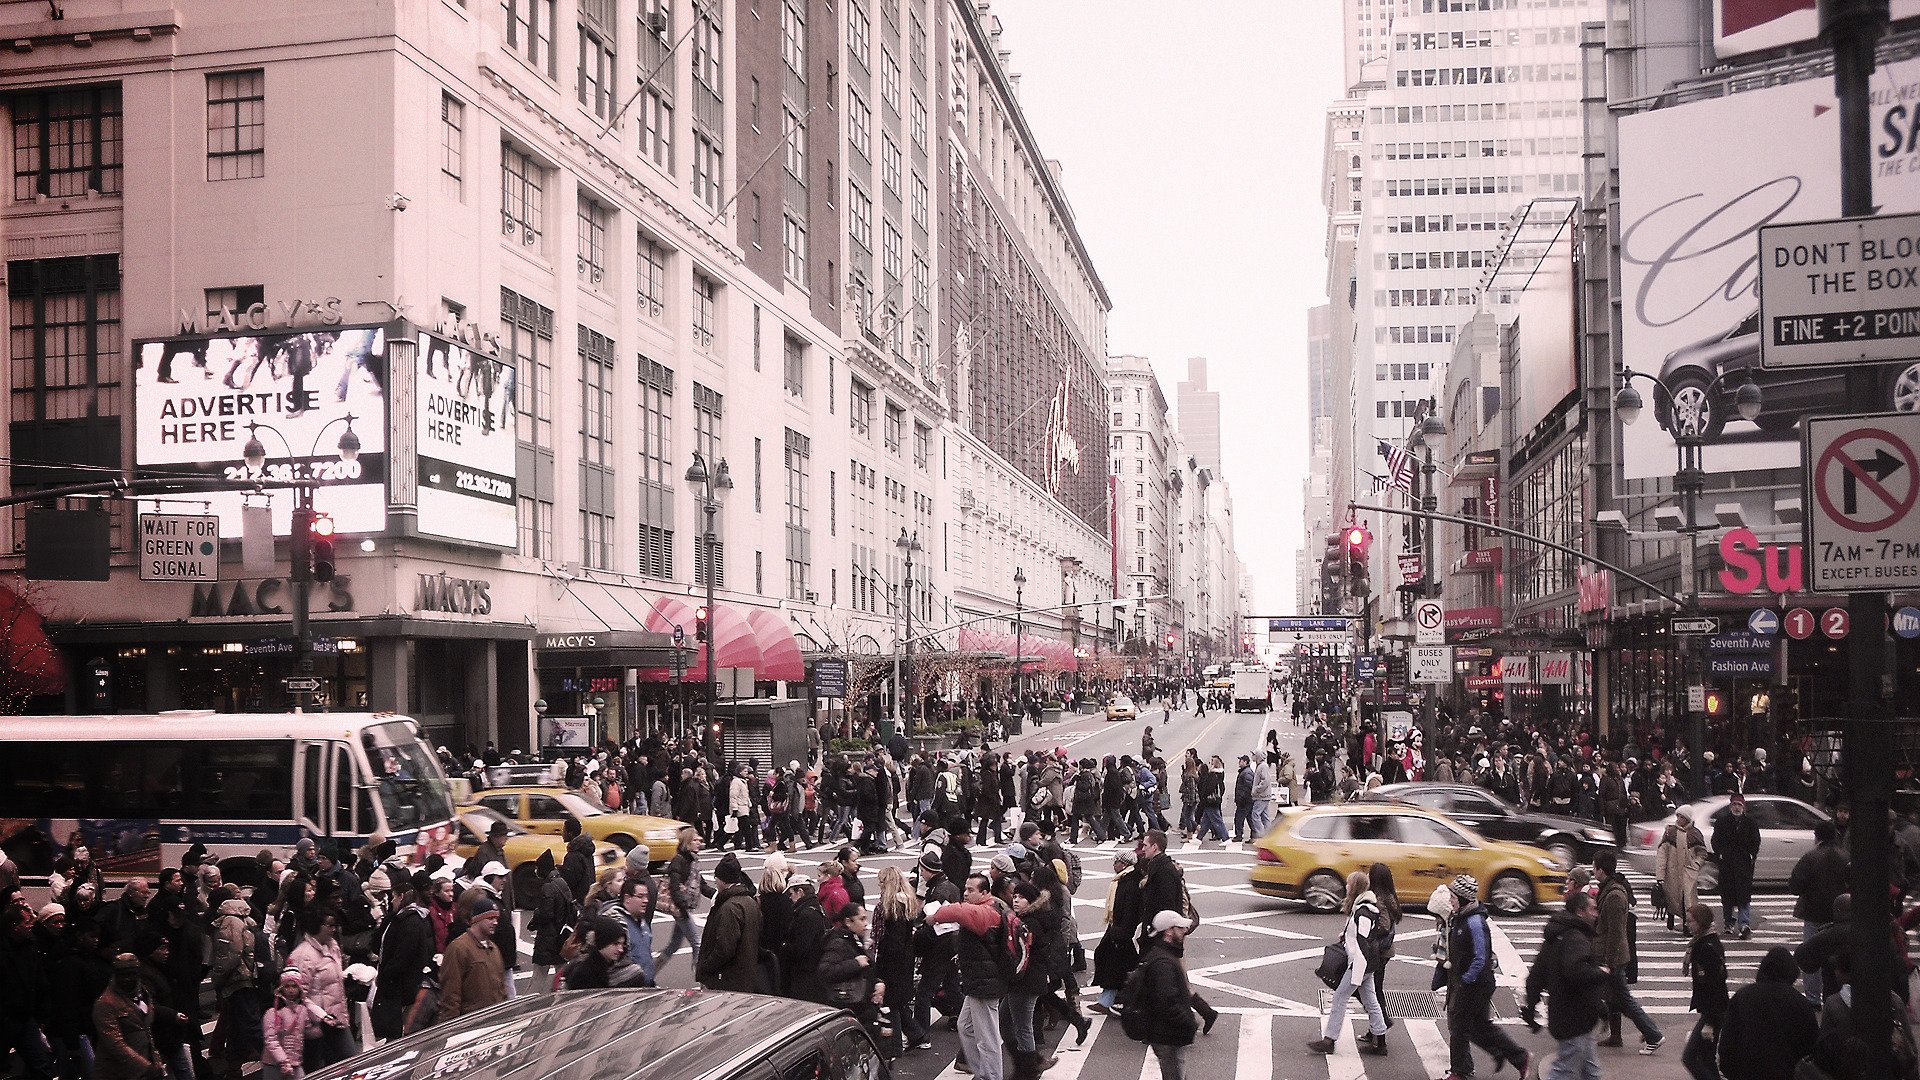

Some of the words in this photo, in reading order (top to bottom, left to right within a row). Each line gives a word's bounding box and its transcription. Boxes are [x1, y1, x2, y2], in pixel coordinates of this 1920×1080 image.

[1774, 242, 1850, 268] DON'T
[1807, 271, 1856, 295] THE
[1868, 266, 1918, 291] BOX
[1780, 317, 1824, 342] FINE
[1833, 315, 1866, 338] +2
[160, 390, 320, 420] ADVERTISE
[428, 393, 496, 433] ADVERTISE
[161, 420, 236, 445] HERE
[428, 417, 462, 446] HERE
[144, 520, 178, 536] WAIT
[187, 521, 215, 536] FOR
[145, 540, 194, 556] GREEN
[152, 560, 206, 577] SIGNAL
[1822, 566, 1870, 580] EXCEPT
[1875, 565, 1918, 578] BUSES
[414, 572, 492, 615] MACY'S
[1470, 618, 1492, 626] STEAKS
[1697, 622, 1712, 630] WAY
[1793, 613, 1804, 634] 1
[1829, 613, 1844, 634] 2
[1894, 612, 1920, 631] MTA
[244, 642, 276, 654] Seventh
[277, 642, 293, 652] Ave
[313, 642, 324, 651] West
[546, 635, 596, 648] MACY'S
[1710, 638, 1749, 648] Seventh
[1751, 638, 1771, 648] Ave
[1418, 649, 1443, 657] BUSES
[1420, 659, 1441, 667] ONLY
[1711, 661, 1749, 672] Fashion
[1750, 661, 1770, 672] Ave
[591, 678, 619, 692] SPORT
